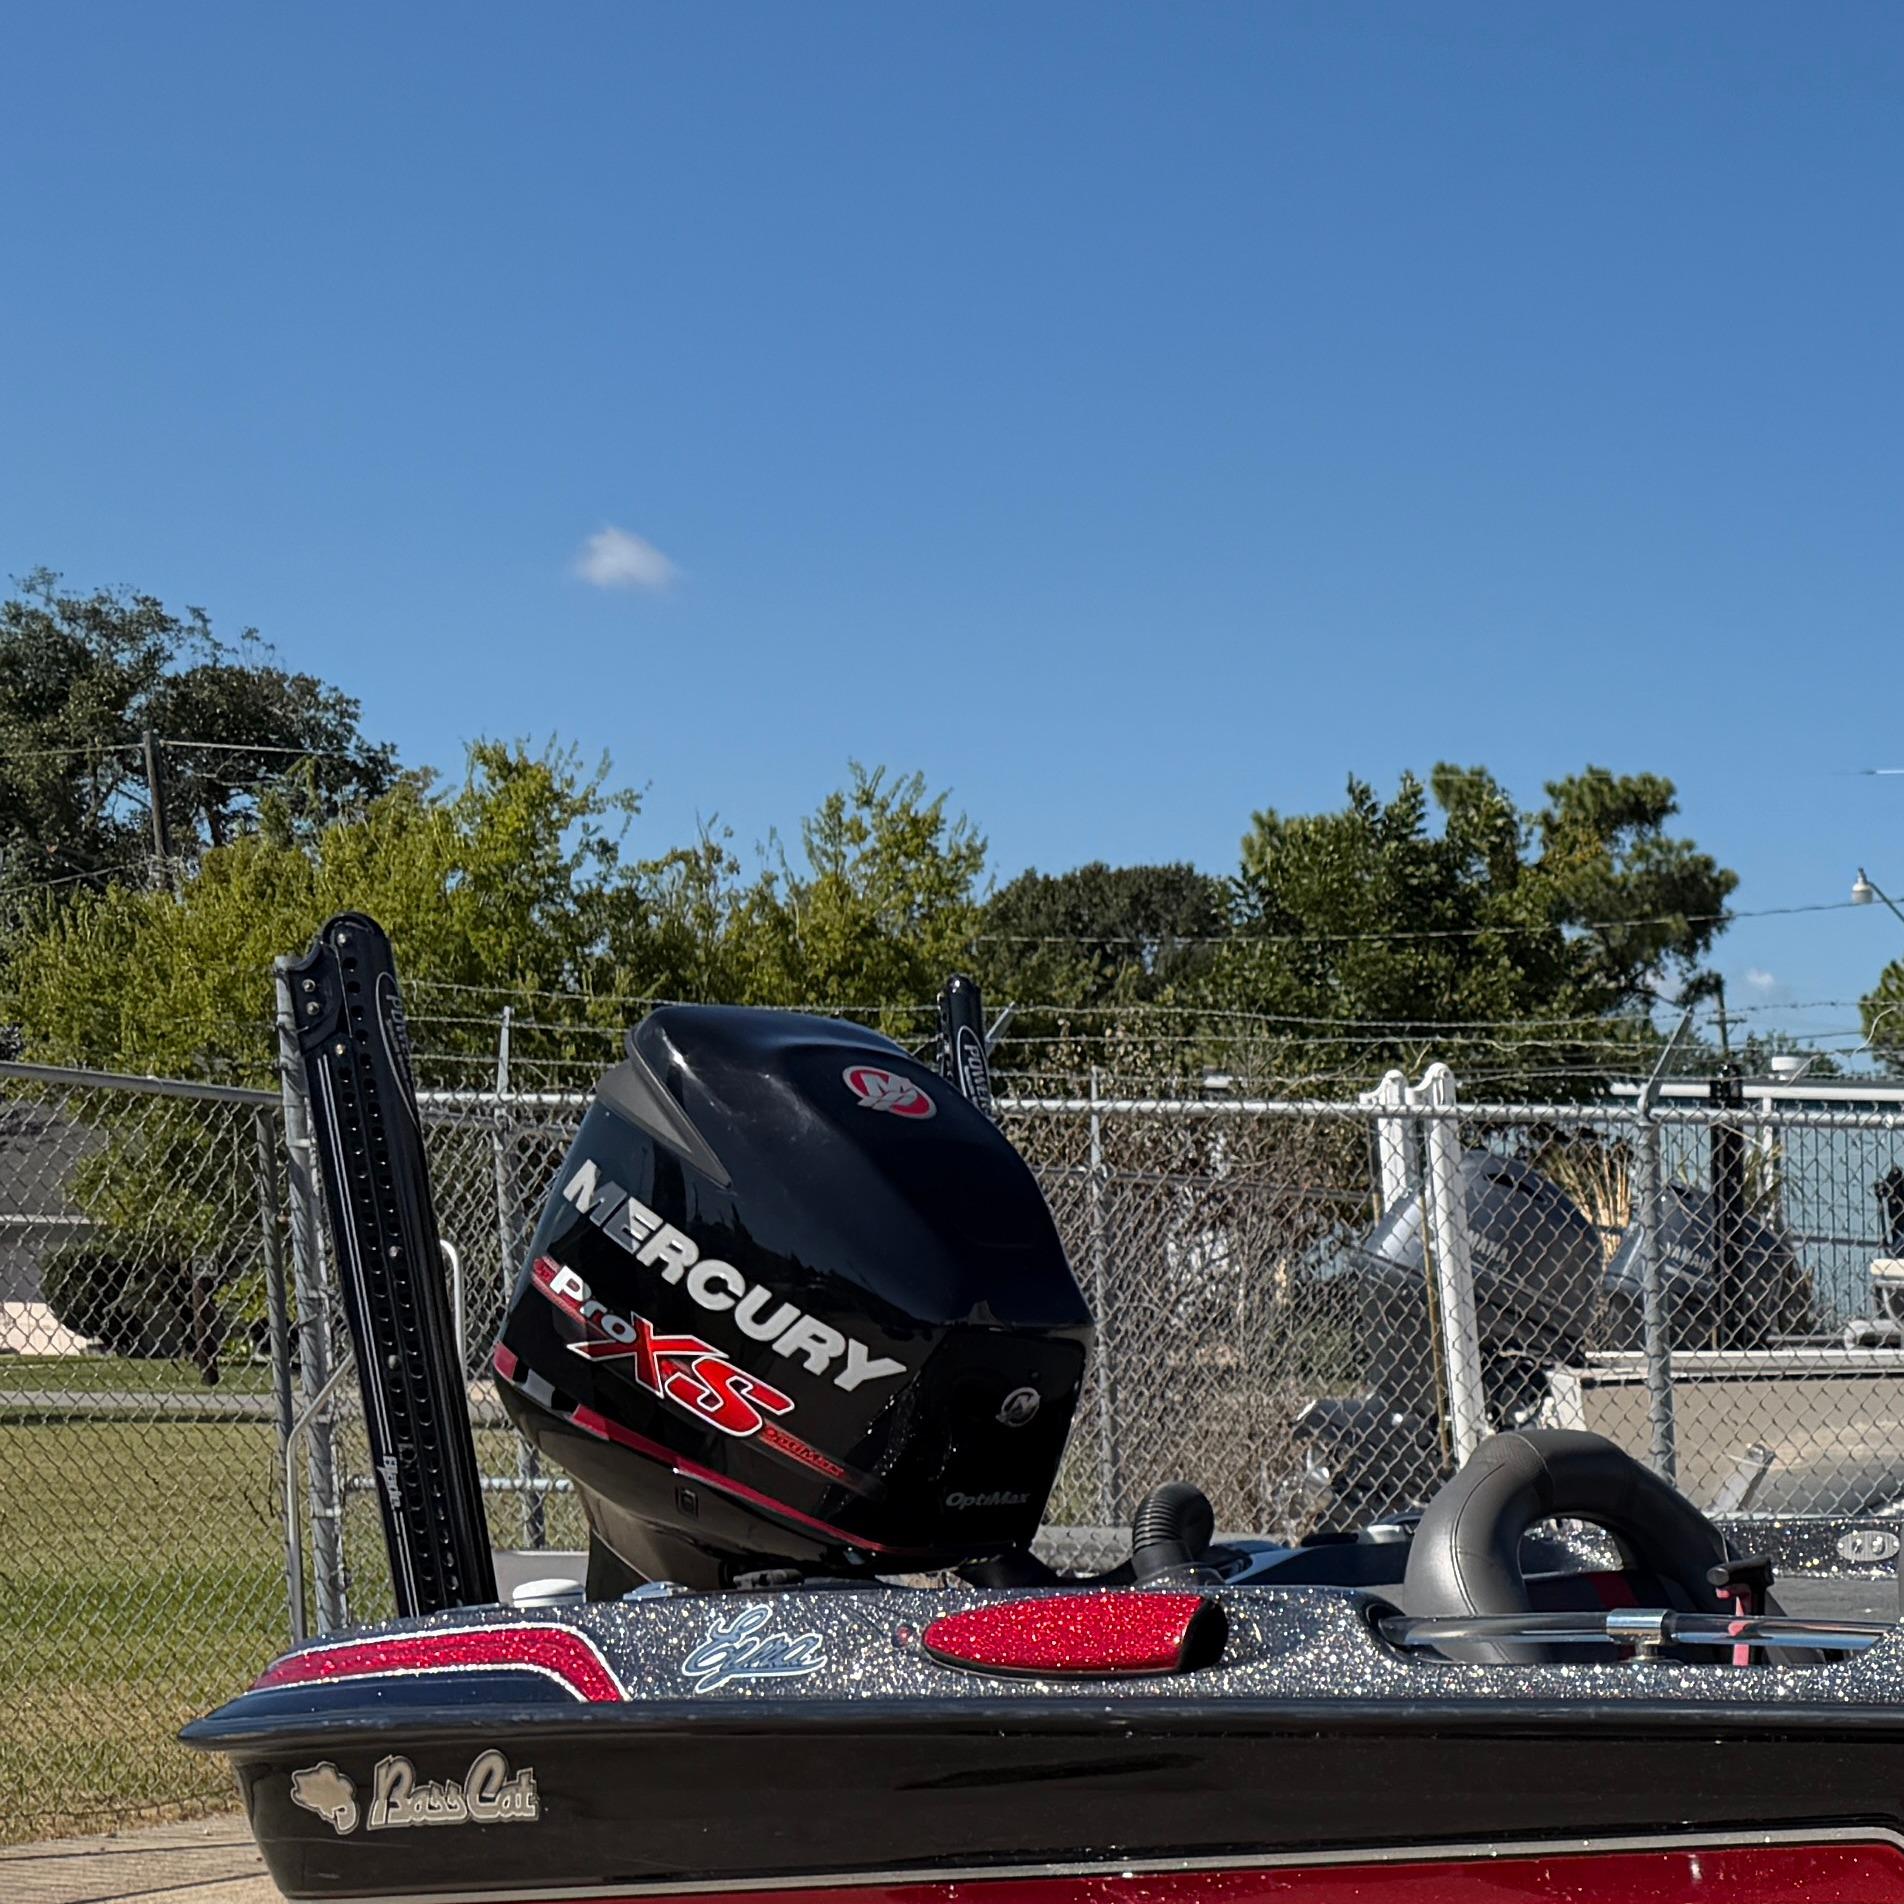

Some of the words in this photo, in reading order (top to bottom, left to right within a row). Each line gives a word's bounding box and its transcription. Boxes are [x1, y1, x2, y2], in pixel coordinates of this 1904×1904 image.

[563, 1159, 908, 1392] MERCURY
[366, 1754, 469, 1831] Bass
[464, 1749, 539, 1823] Cat
